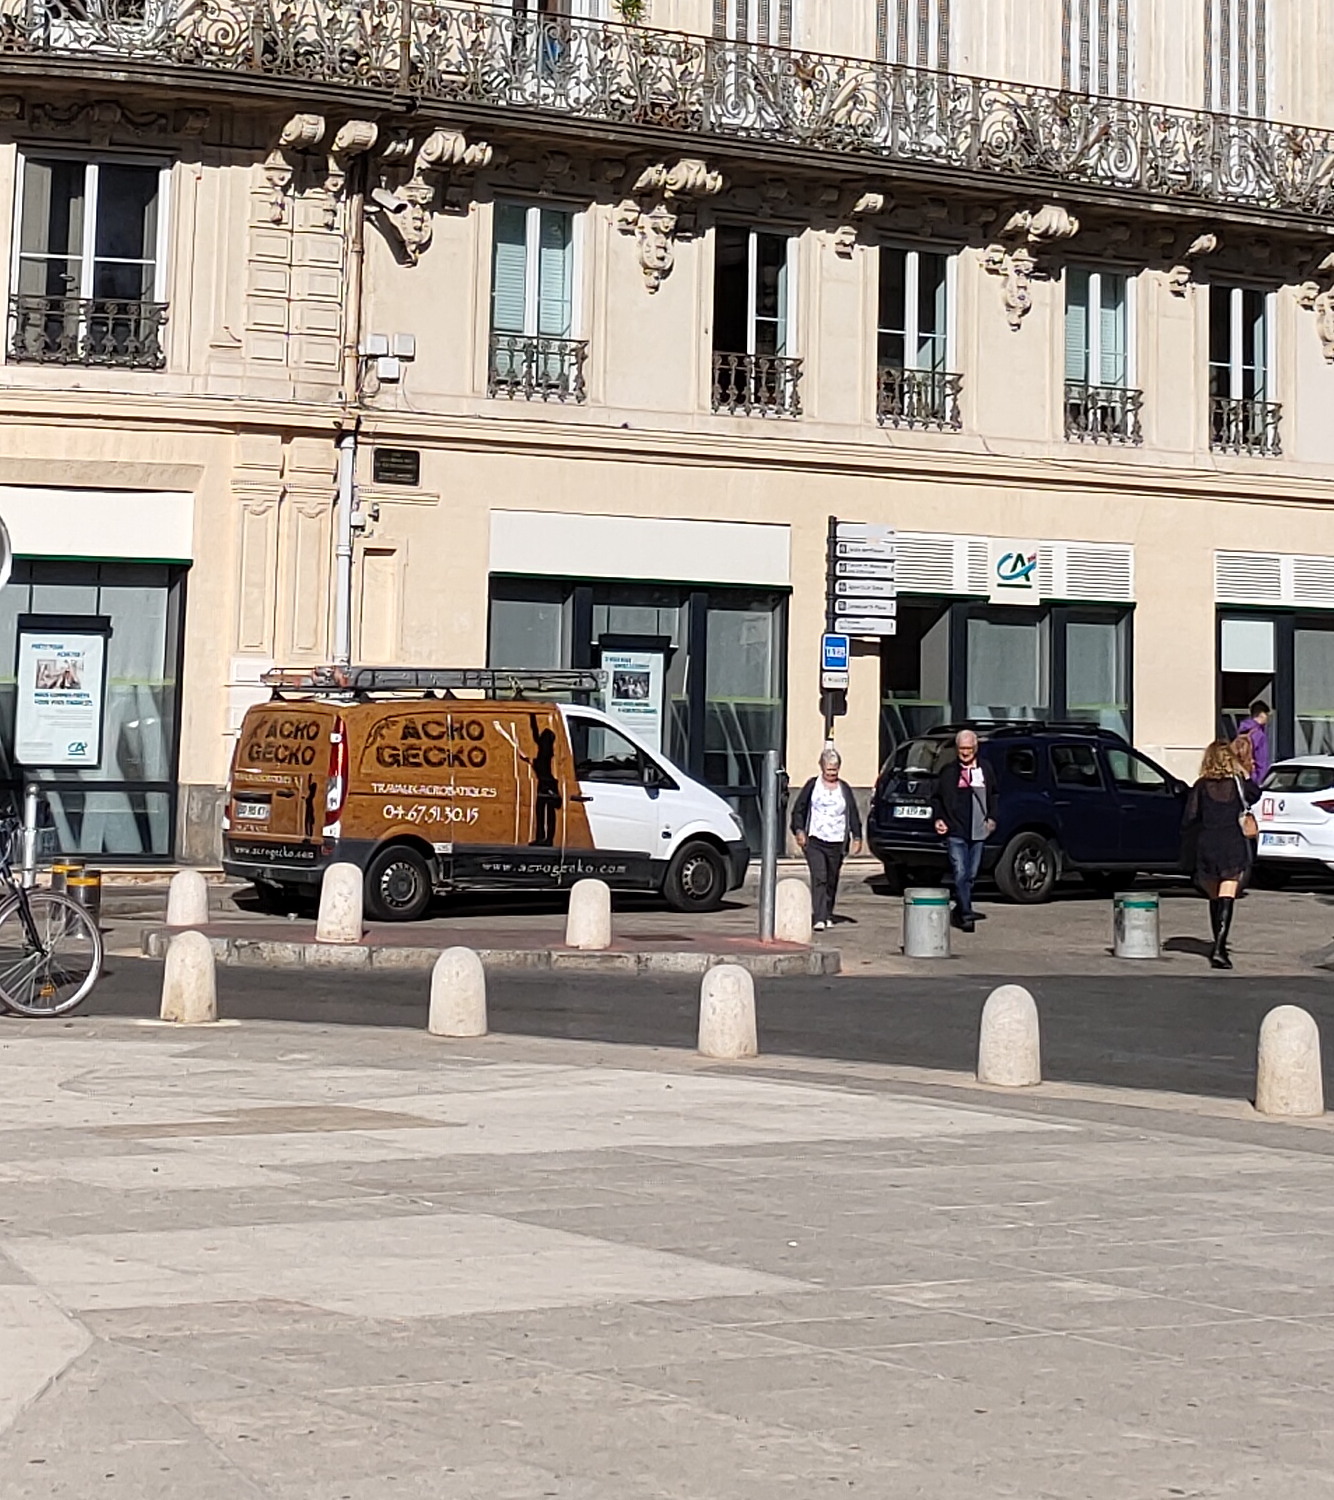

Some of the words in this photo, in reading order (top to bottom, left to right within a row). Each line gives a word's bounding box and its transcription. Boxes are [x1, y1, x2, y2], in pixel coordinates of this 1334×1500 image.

[265, 719, 321, 741] ACRO
[400, 718, 485, 741] ACRO
[248, 742, 316, 765] GECKO
[376, 745, 487, 768] GECKO
[383, 804, 479, 826] 04.67.51.30.15
[482, 858, 627, 877] www.acrogecko.com
